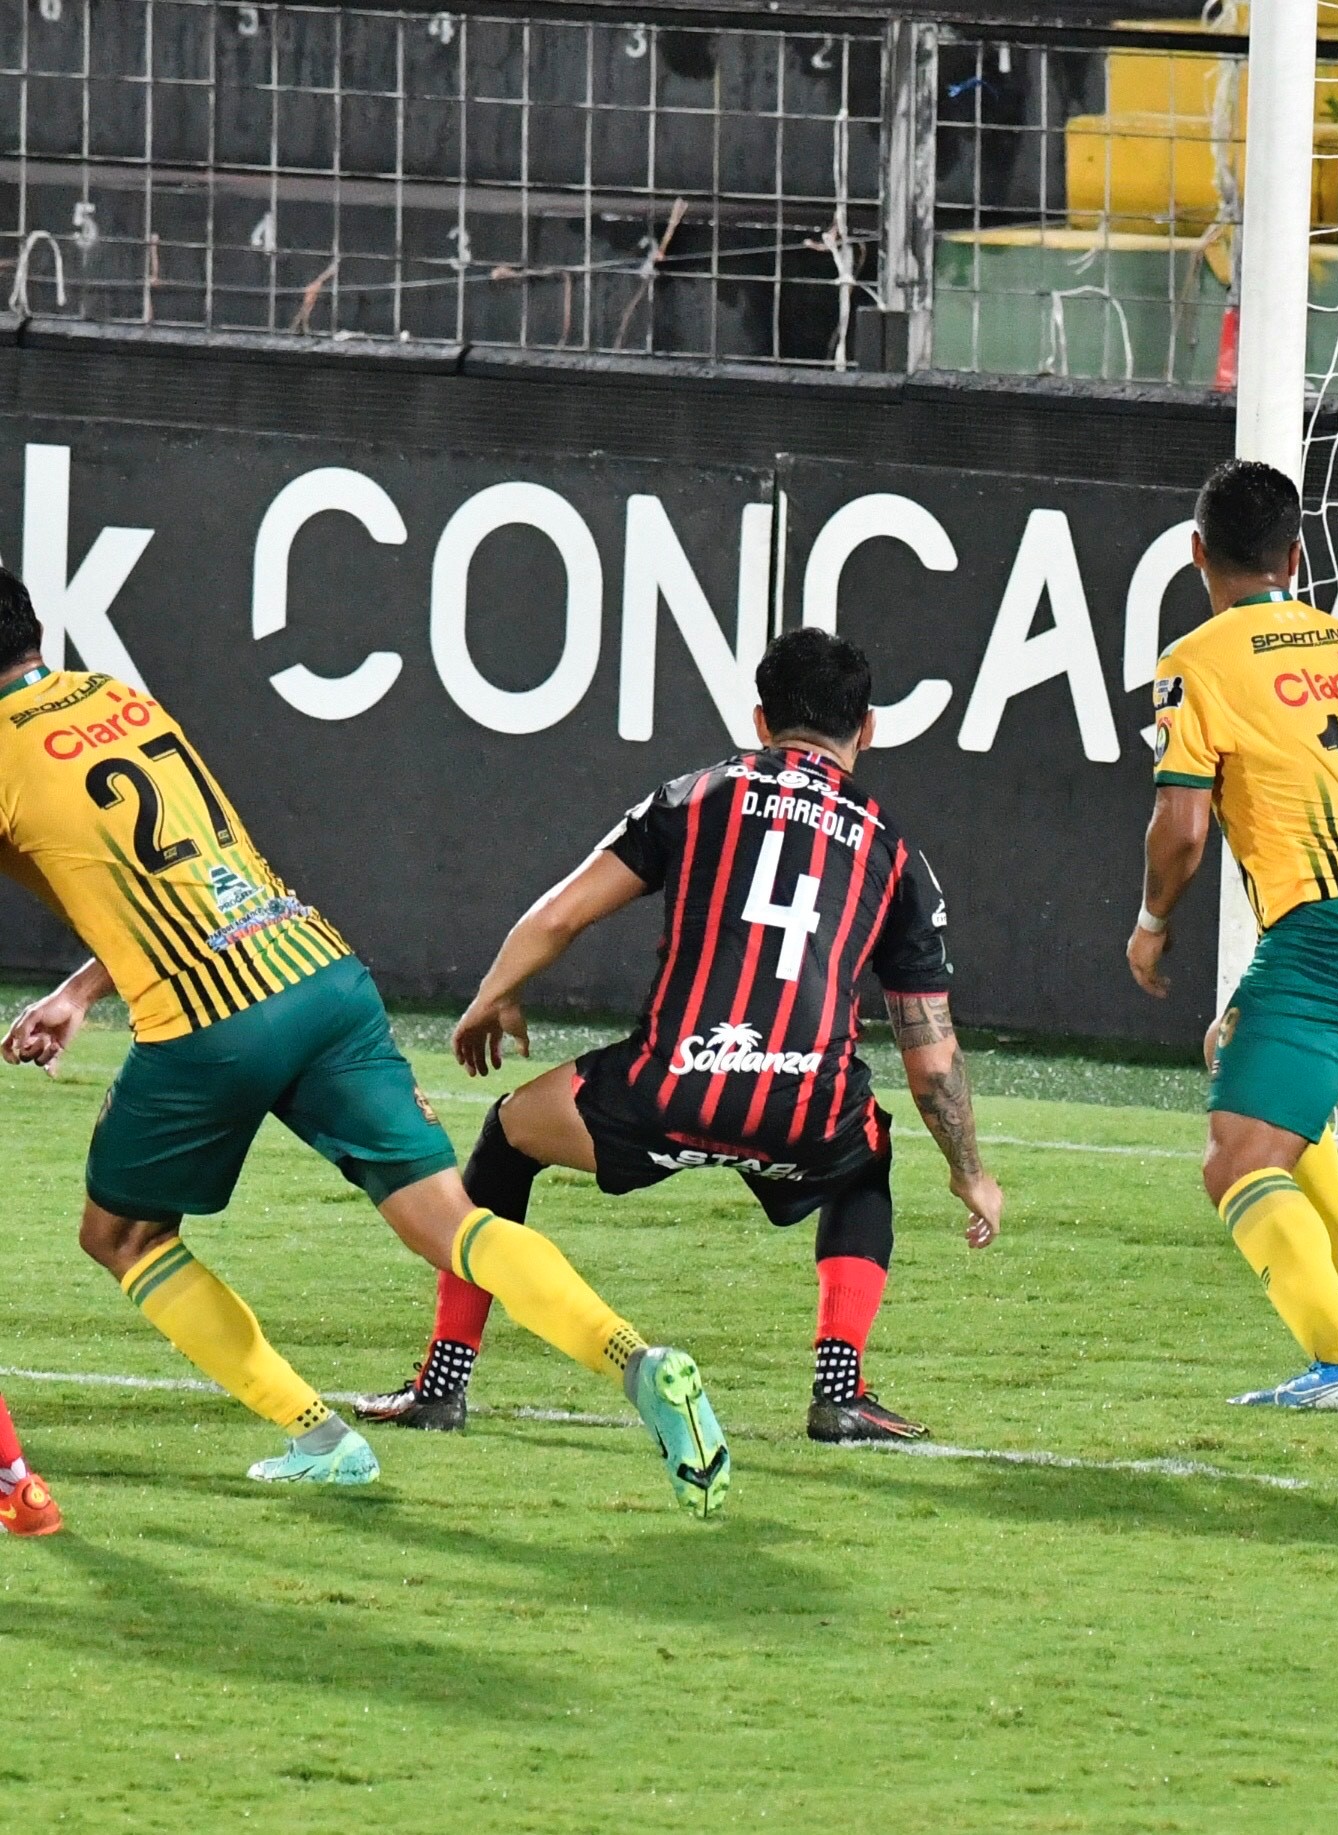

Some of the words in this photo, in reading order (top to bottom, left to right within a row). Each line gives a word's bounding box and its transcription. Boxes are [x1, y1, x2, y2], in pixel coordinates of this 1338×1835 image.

[72, 202, 98, 250] 5
[44, 700, 151, 760] Claro
[85, 732, 238, 875] 27
[741, 791, 864, 851] D.ARREOLA
[740, 830, 821, 982] 4
[668, 1034, 823, 1076] Soldanza
